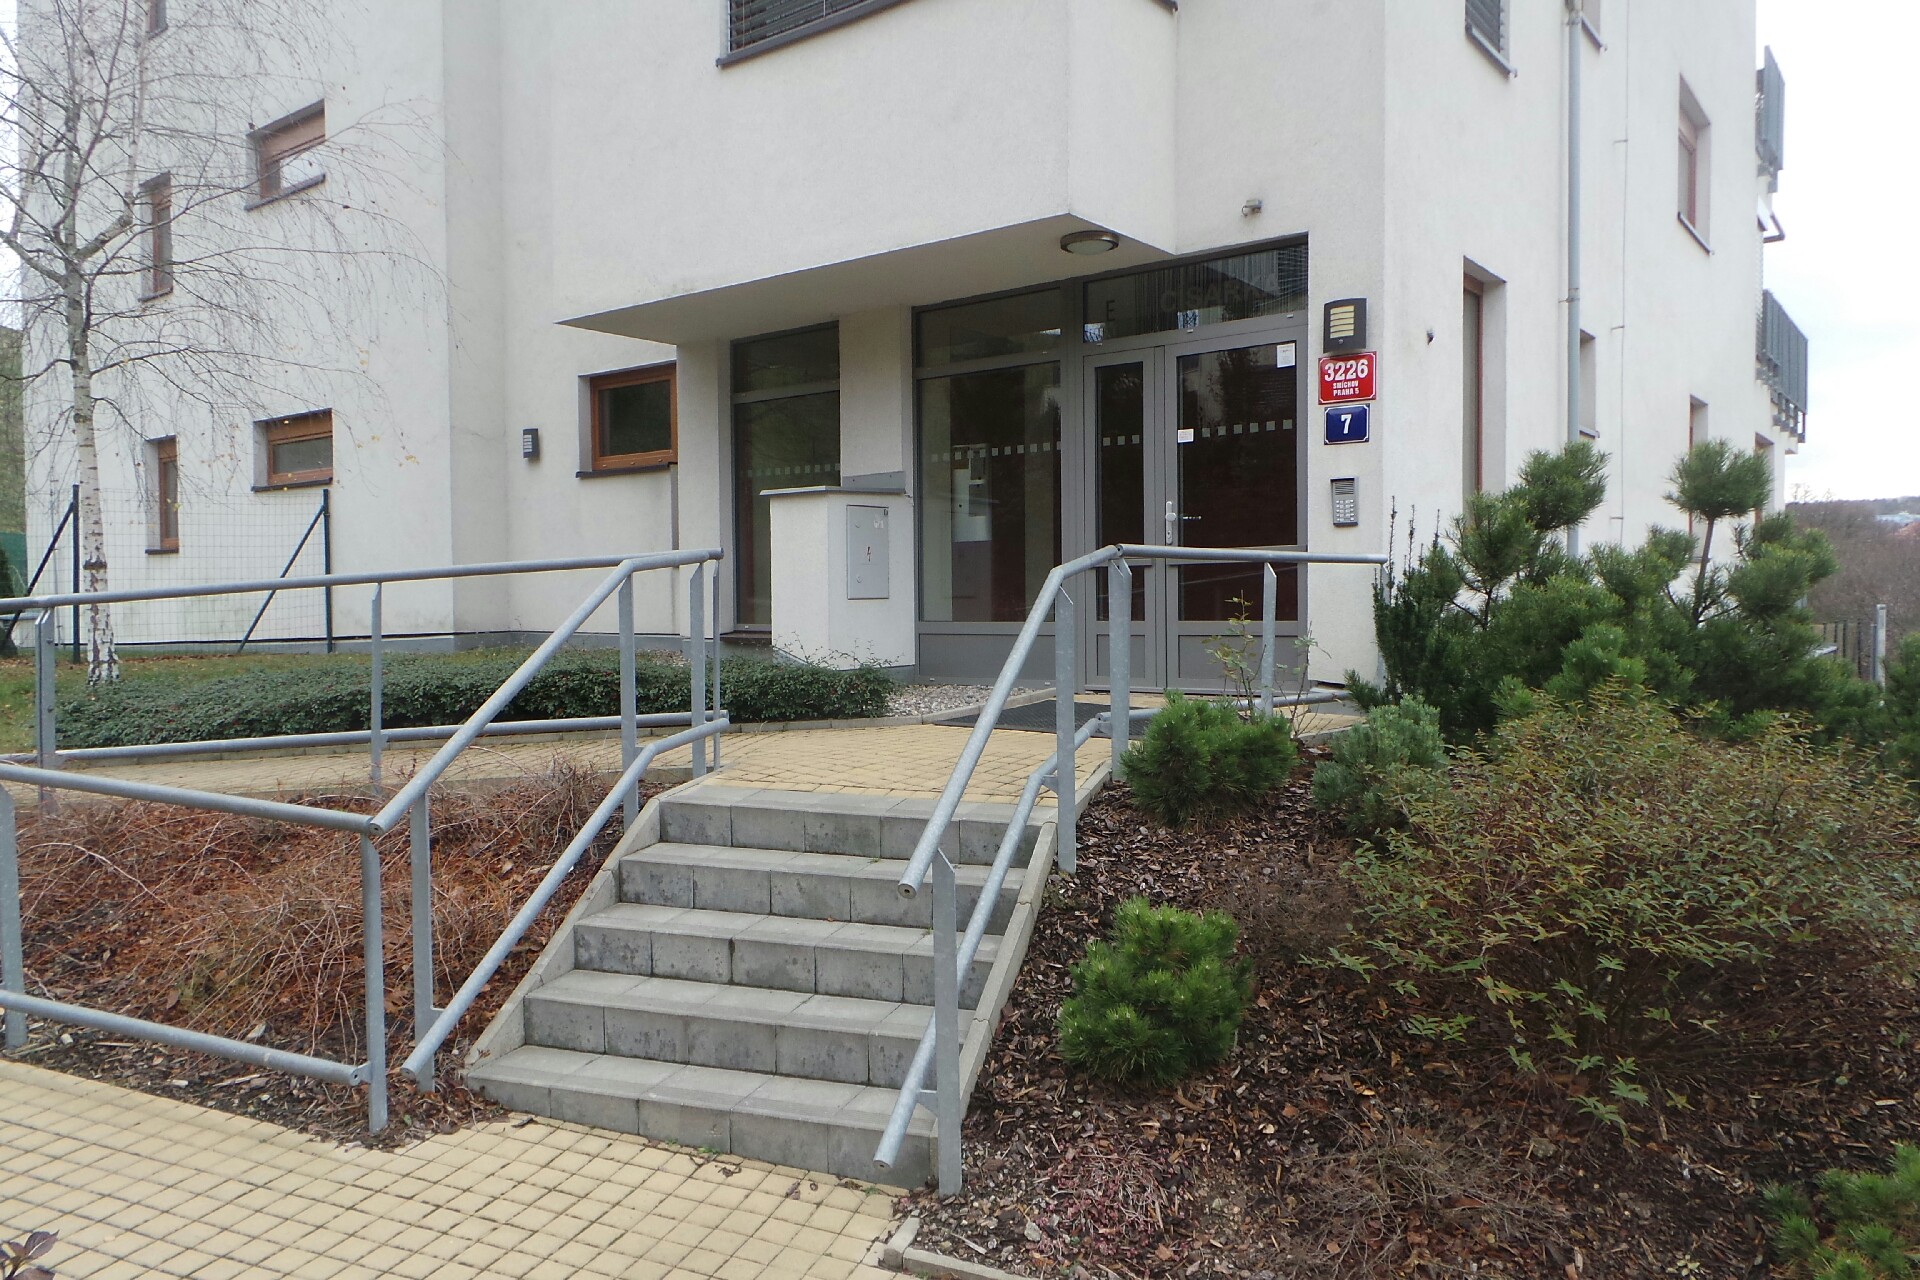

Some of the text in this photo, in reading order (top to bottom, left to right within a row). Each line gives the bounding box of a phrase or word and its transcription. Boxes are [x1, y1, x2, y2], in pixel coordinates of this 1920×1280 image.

[1324, 359, 1368, 381] 3226
[1333, 380, 1359, 389] SMÍCHOV
[1333, 388, 1354, 397] PRAHA
[1341, 413, 1352, 434] 7
